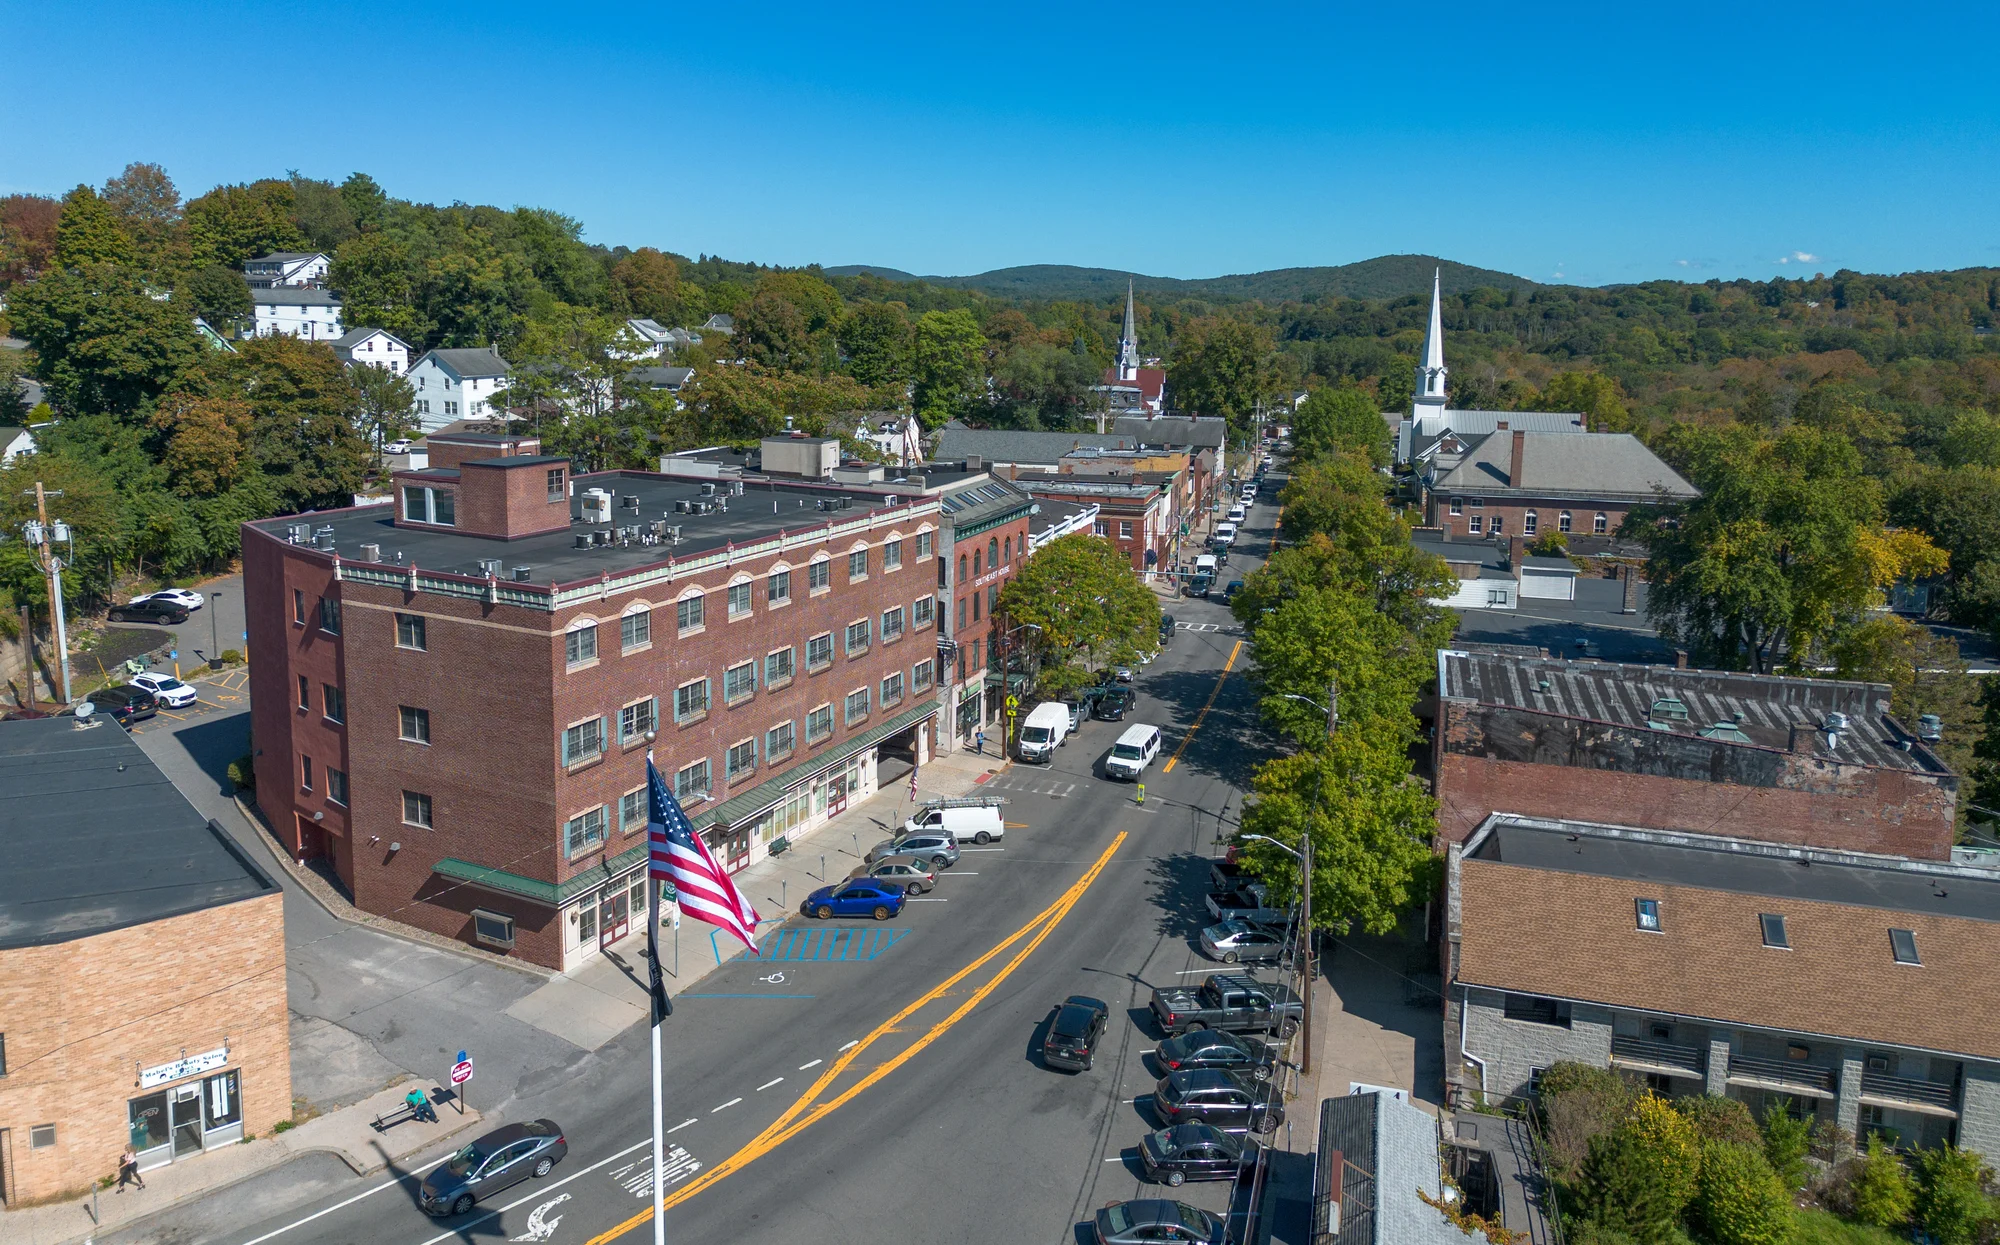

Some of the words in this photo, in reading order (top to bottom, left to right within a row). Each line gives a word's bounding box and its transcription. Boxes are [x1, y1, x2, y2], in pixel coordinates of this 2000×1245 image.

[975, 570, 998, 587] SOUTHEAST
[998, 565, 1010, 577] HOUSE
[203, 1053, 223, 1061] Salon
